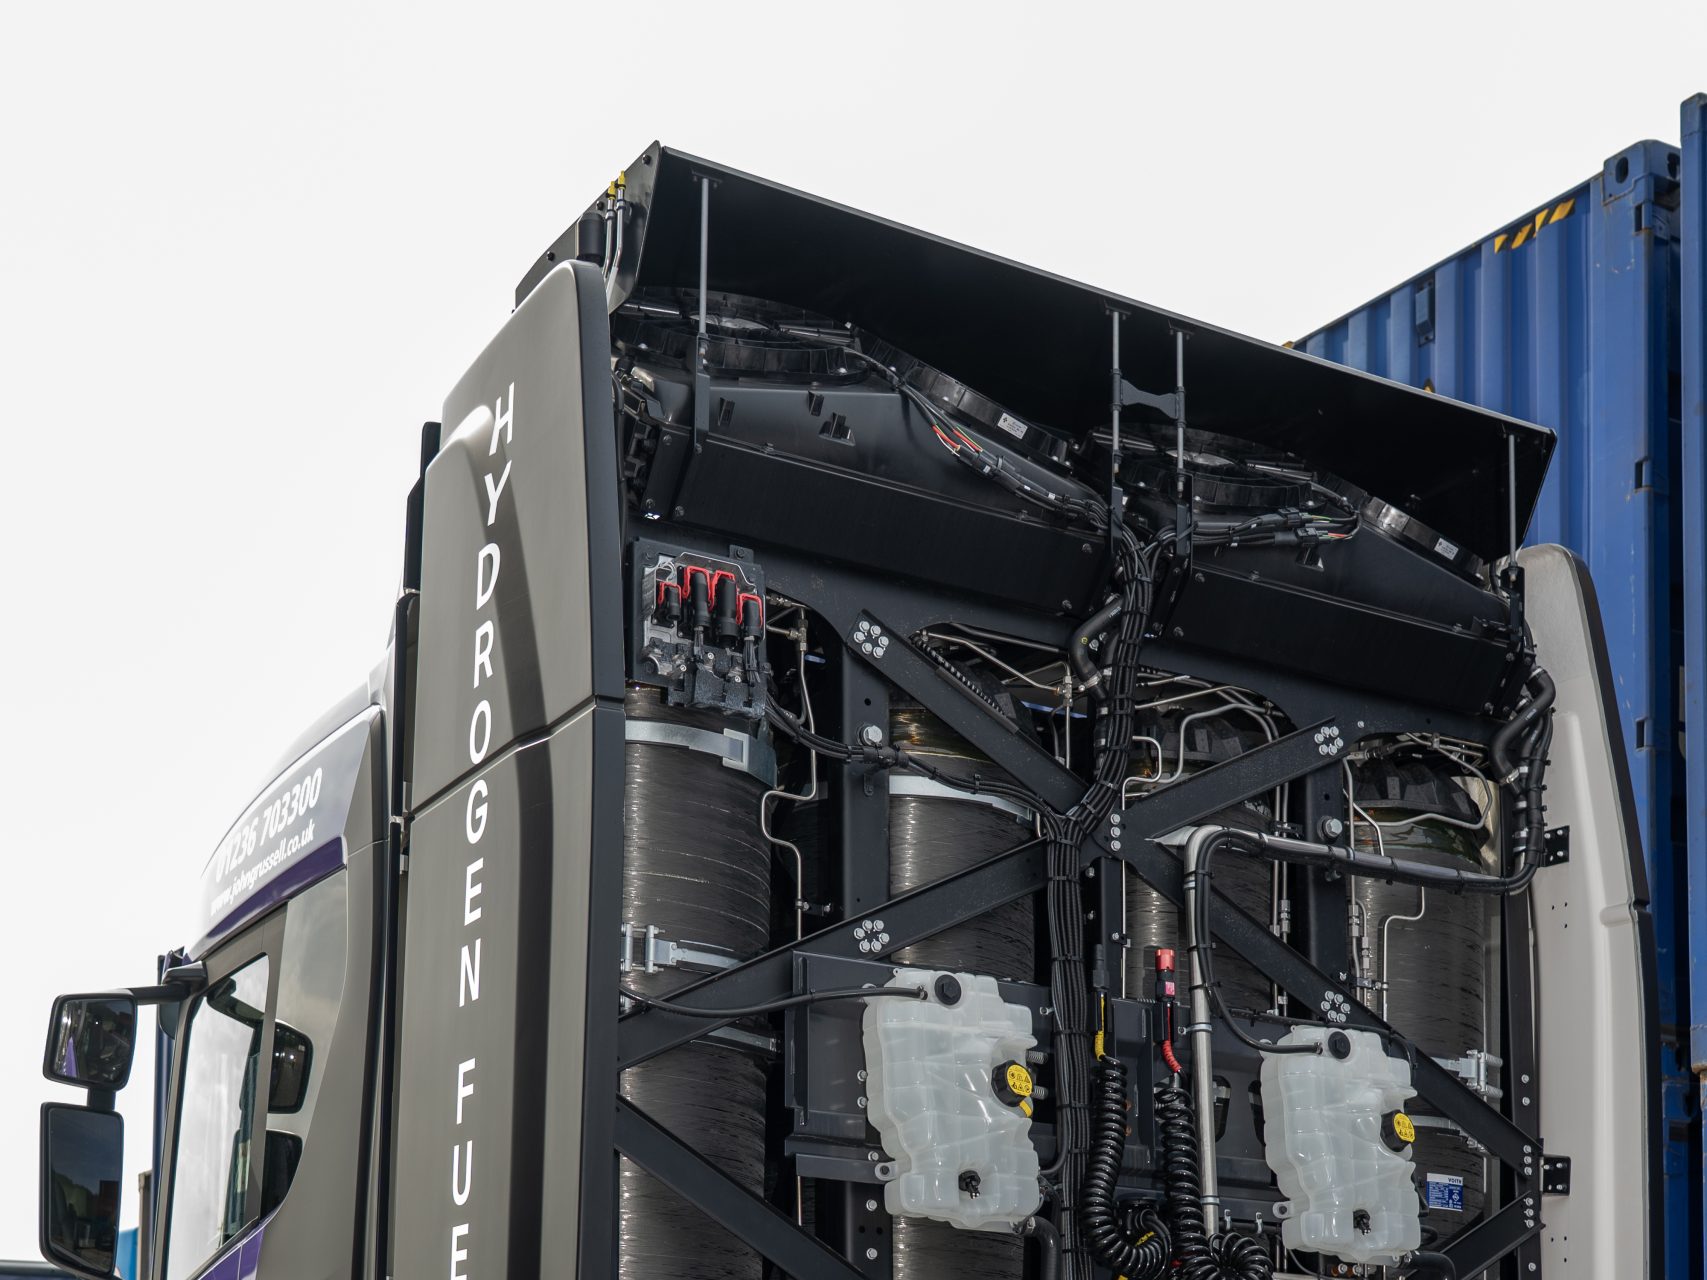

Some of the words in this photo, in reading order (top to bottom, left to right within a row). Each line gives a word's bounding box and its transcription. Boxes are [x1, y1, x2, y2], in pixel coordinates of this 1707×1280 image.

[459, 382, 515, 1007] HYDROGEN
[260, 767, 323, 847] 703300
[211, 819, 316, 916] www.johngrussell.co.uk
